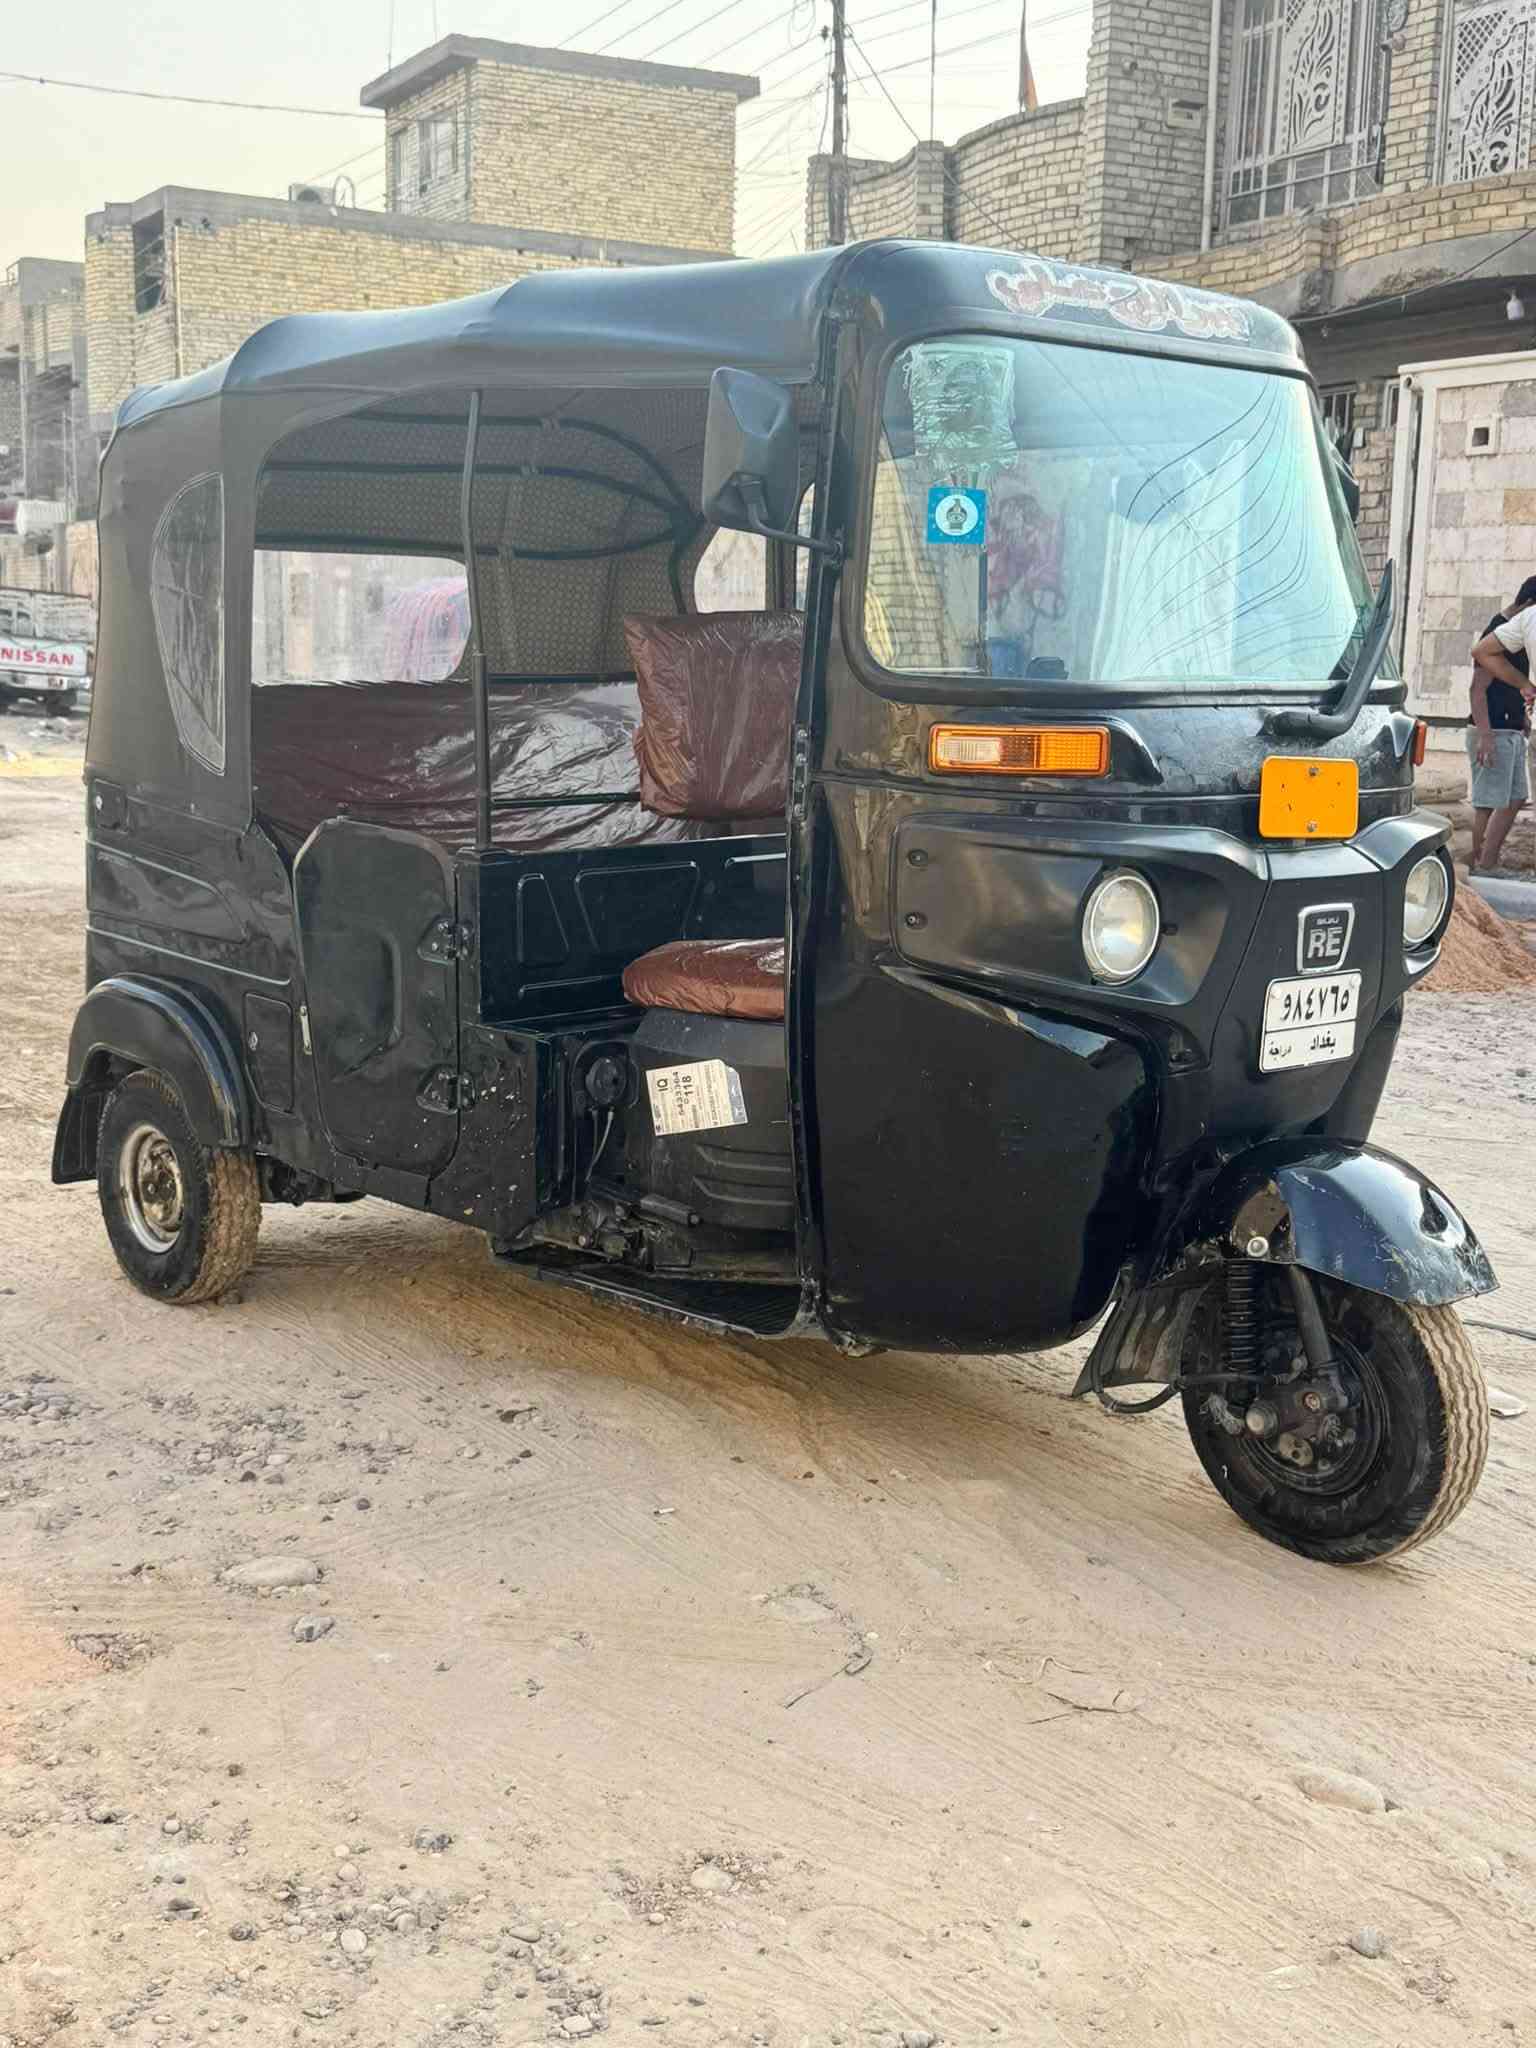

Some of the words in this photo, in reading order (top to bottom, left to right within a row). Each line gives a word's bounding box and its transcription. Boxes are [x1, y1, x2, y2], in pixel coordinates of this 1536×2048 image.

[1, 647, 74, 665] NISSAN
[1307, 927, 1343, 958] RE
[1281, 985, 1350, 1021] ٩٨٤٧٦٥
[1310, 1030, 1337, 1054] بغداد
[656, 1078, 669, 1092] IQ
